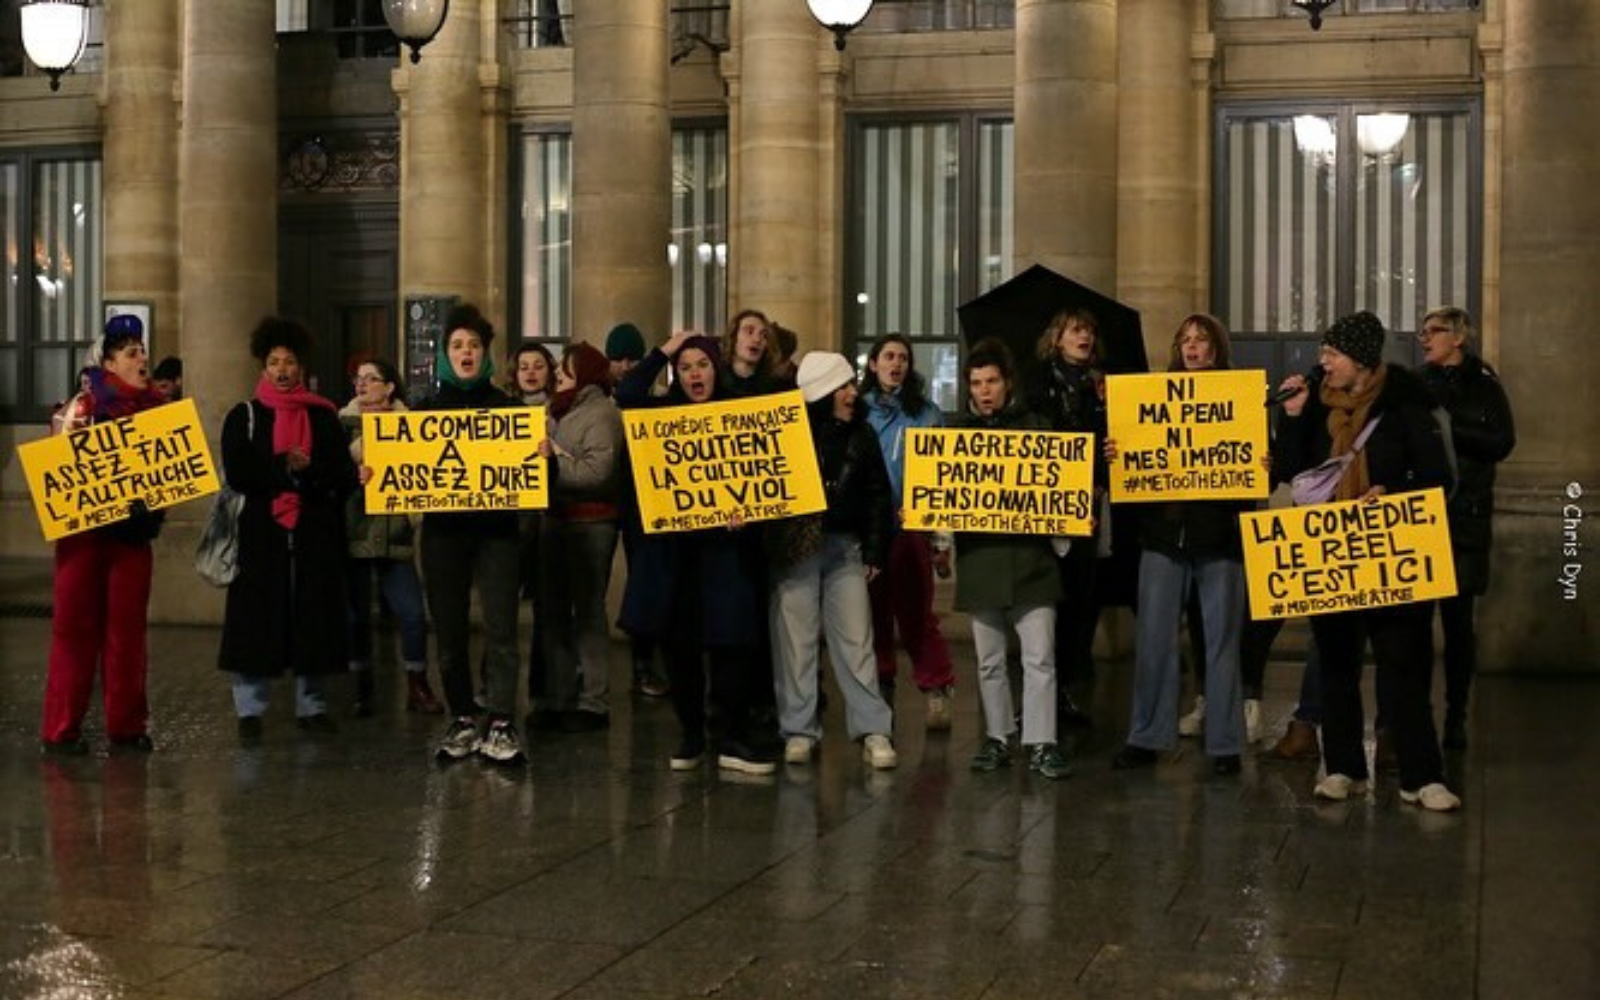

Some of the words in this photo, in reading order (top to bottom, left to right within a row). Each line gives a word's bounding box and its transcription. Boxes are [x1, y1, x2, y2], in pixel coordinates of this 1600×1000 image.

[1167, 377, 1194, 402] NI
[375, 415, 414, 443] LA
[420, 409, 532, 442] COMÉDIE
[631, 422, 649, 440] LA
[653, 415, 714, 439] COMÉDIE
[720, 406, 801, 433] FRANÇAISE
[1138, 403, 1171, 424] MA
[1181, 401, 1234, 423] PEAU
[437, 440, 465, 467] A
[663, 429, 782, 465] SOUTIENT
[914, 433, 945, 456] UN
[953, 432, 1087, 462] AGRESSEUR
[1167, 427, 1192, 448] NI
[43, 454, 130, 498] ASSEZ
[133, 425, 192, 466] FAIT
[379, 463, 471, 492] ASSEZ
[480, 452, 540, 492] DURÉ
[1124, 448, 1169, 471] MES
[1181, 440, 1253, 468] IMPÔTS
[45, 453, 209, 521] L'AUTRUCHE
[650, 466, 679, 490] LA
[689, 456, 792, 483] CULTURE
[936, 461, 1005, 486] PARMI
[1016, 461, 1061, 488] LES
[673, 488, 717, 511] DU
[725, 478, 797, 505] VIOL
[912, 485, 1089, 520] PENSIONNAIRES
[1251, 516, 1286, 543] LA
[1304, 496, 1437, 537] COMÉDIE,
[1275, 543, 1307, 570] LE
[1322, 531, 1415, 564] RÉEL
[1268, 564, 1360, 599] C'EST
[1379, 555, 1433, 588] ICI
